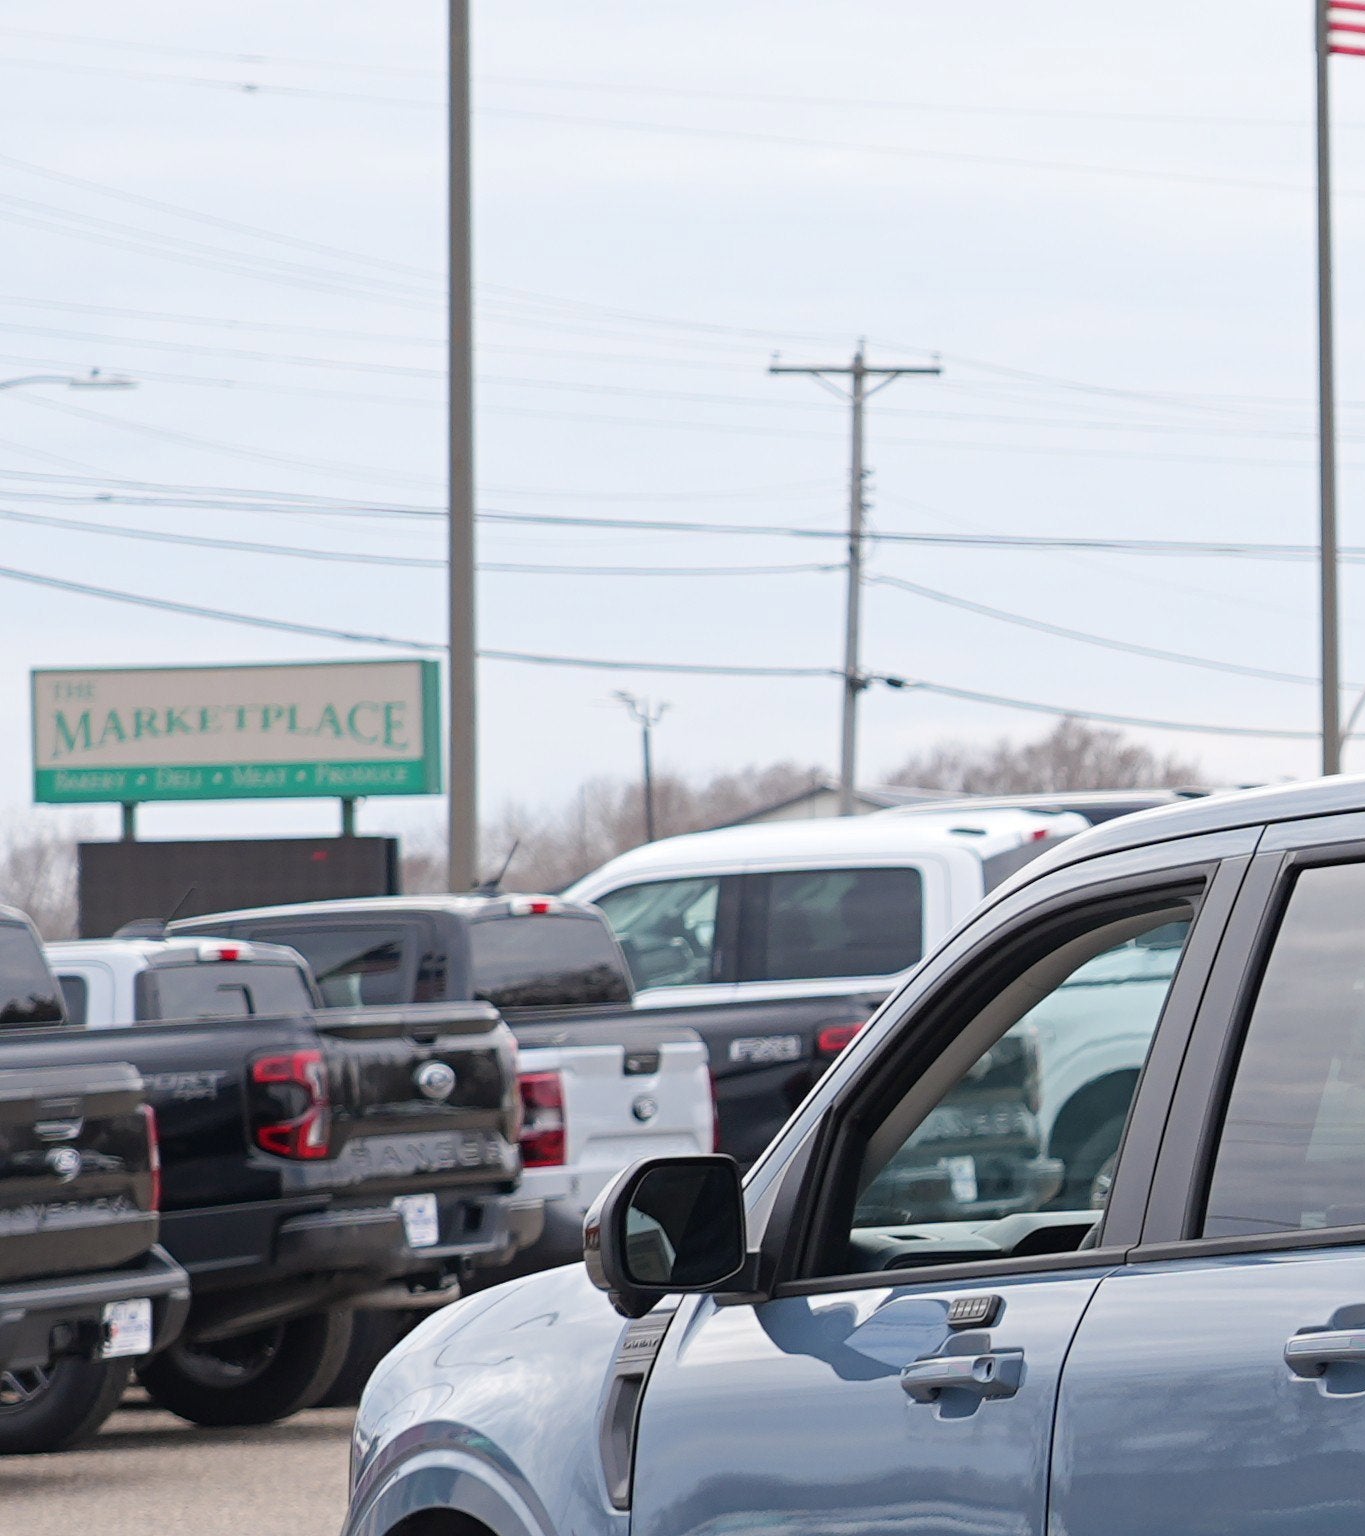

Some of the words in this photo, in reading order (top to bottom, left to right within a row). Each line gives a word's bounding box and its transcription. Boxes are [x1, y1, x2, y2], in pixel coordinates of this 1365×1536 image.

[52, 679, 96, 700] THE
[50, 700, 410, 760] MARKETPLACE
[314, 763, 408, 785] PRODUCE
